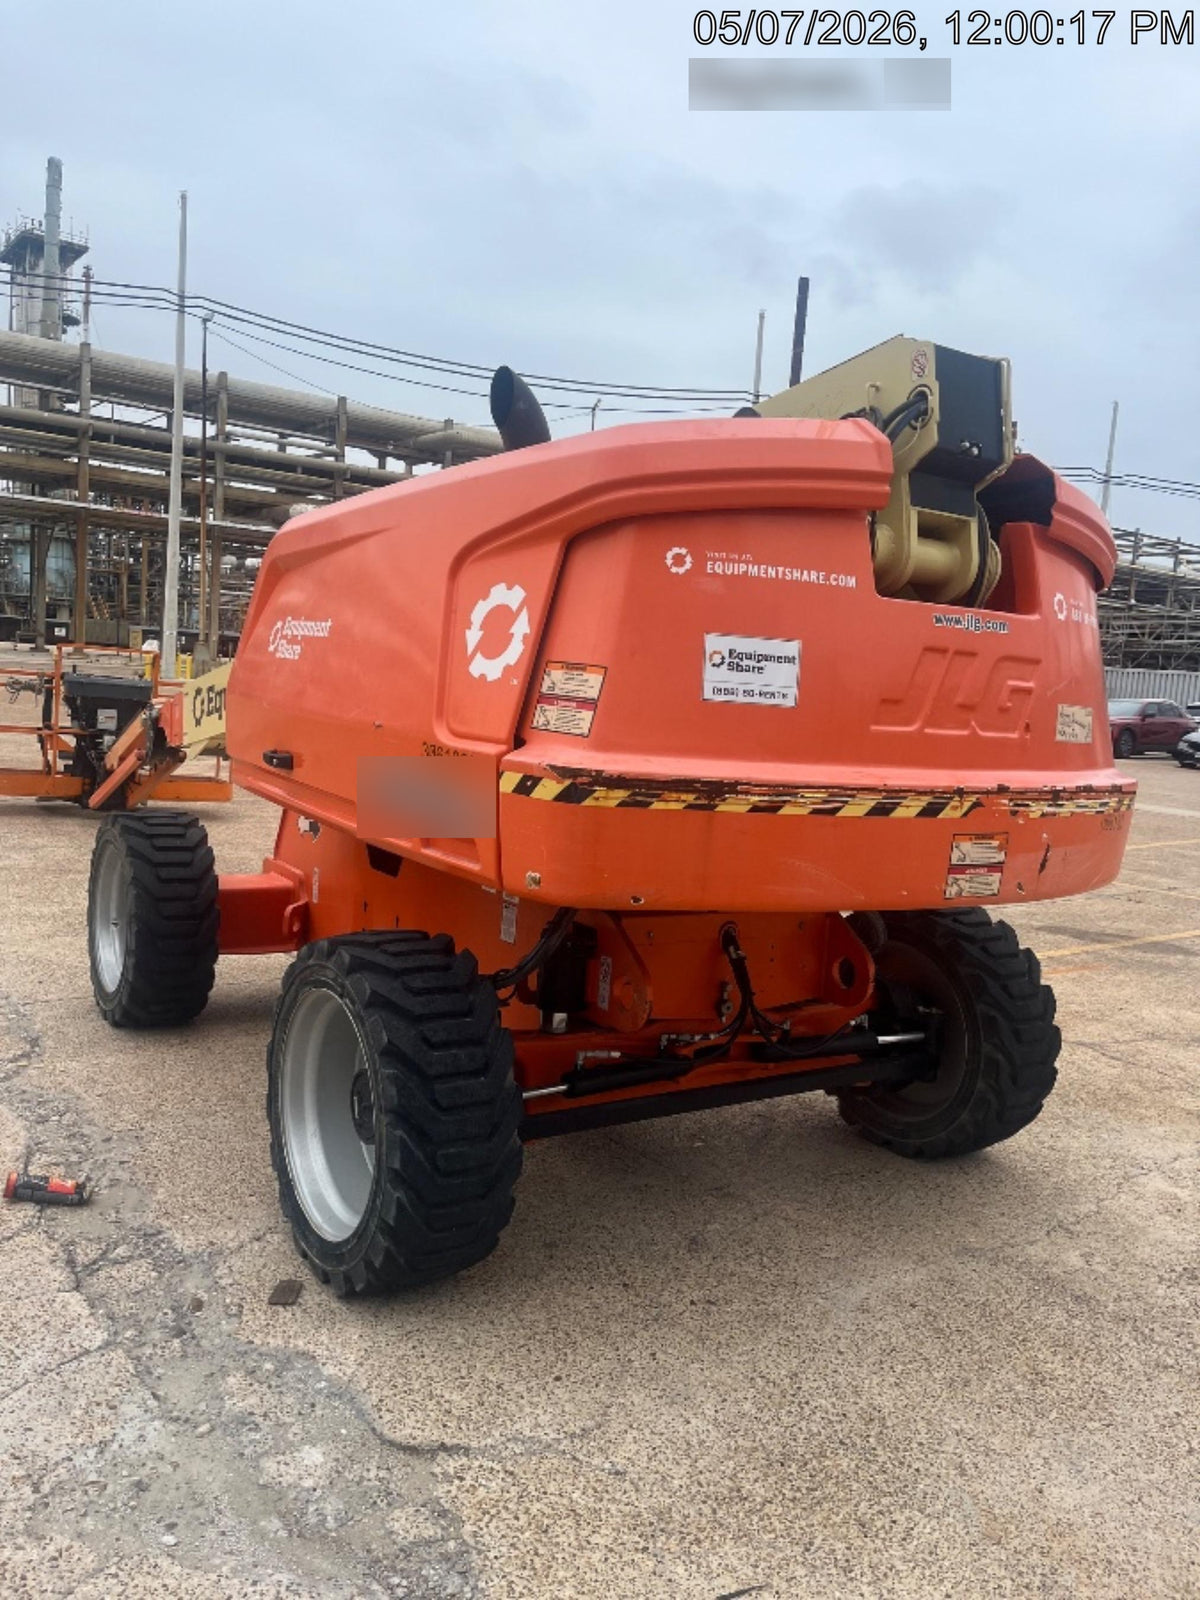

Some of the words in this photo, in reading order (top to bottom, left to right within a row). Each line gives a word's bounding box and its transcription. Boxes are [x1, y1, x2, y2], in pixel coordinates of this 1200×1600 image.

[706, 561, 857, 589] EQUIPMENTSHARE.COM
[933, 613, 1009, 633] www.jlg.com
[728, 648, 797, 666] Equipment
[727, 661, 765, 674] Share
[869, 645, 1042, 739] JLG
